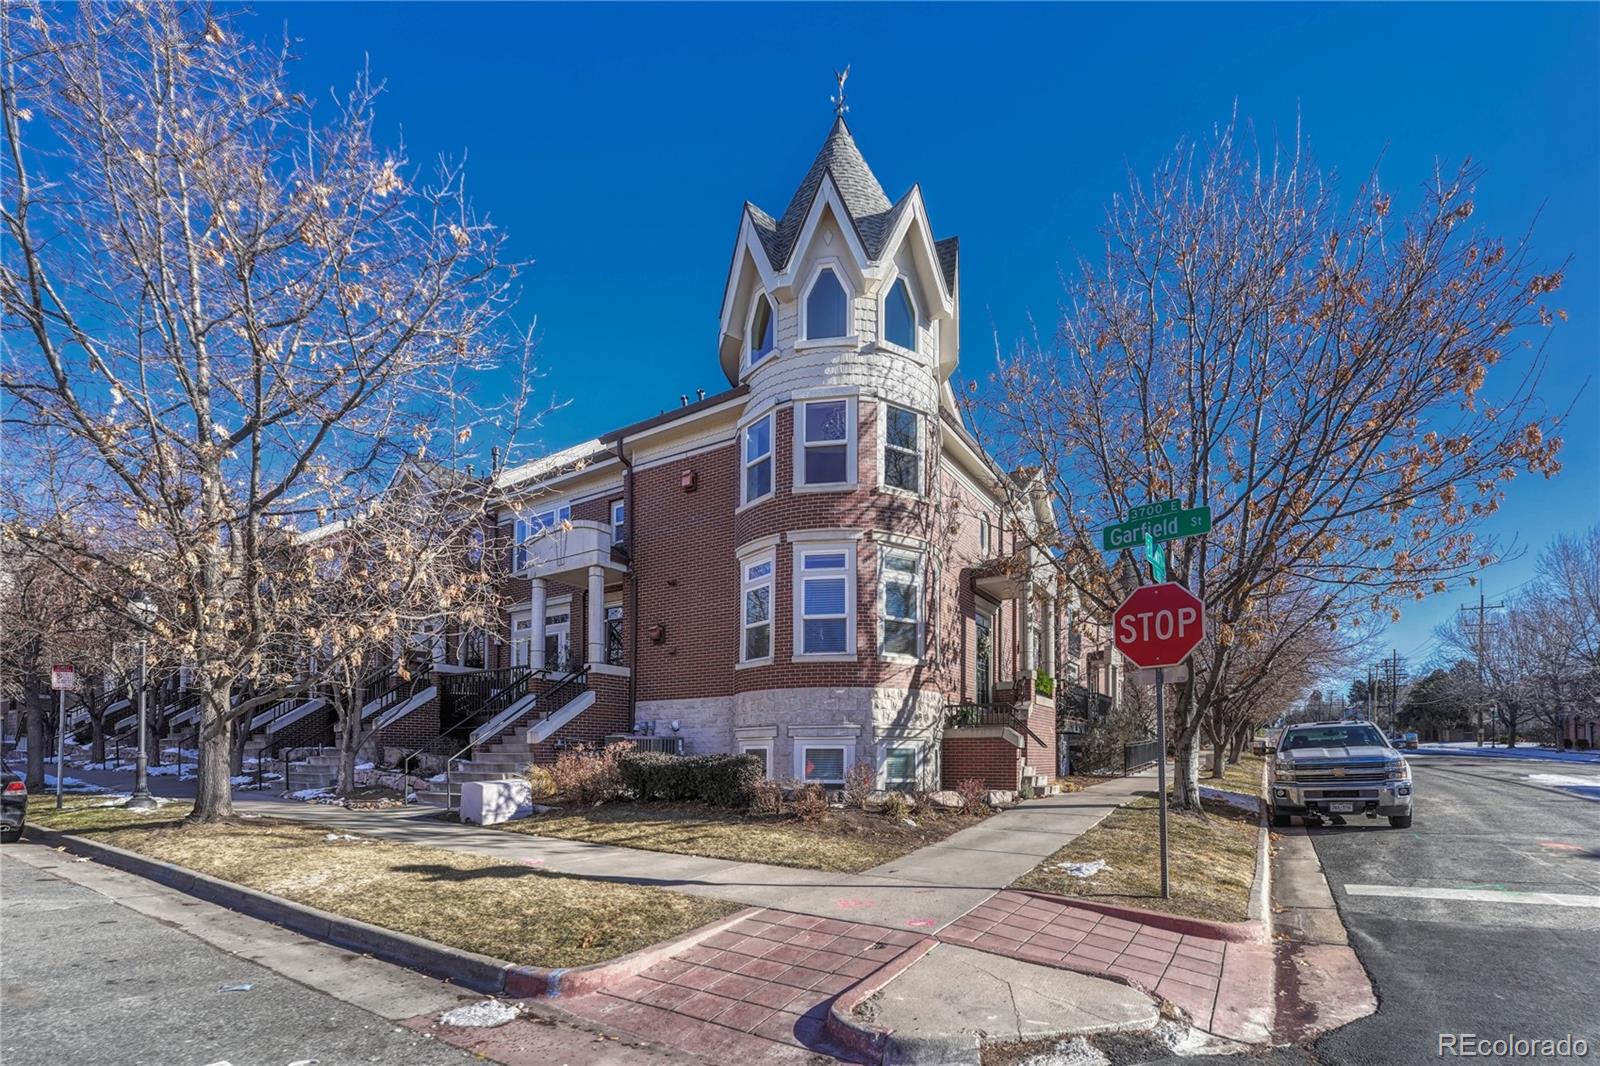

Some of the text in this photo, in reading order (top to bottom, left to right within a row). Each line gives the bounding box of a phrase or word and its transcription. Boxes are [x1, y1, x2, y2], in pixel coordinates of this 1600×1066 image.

[1131, 501, 1178, 519] 3700 E
[1110, 516, 1202, 546] Garfield St
[1120, 607, 1197, 644] STOP
